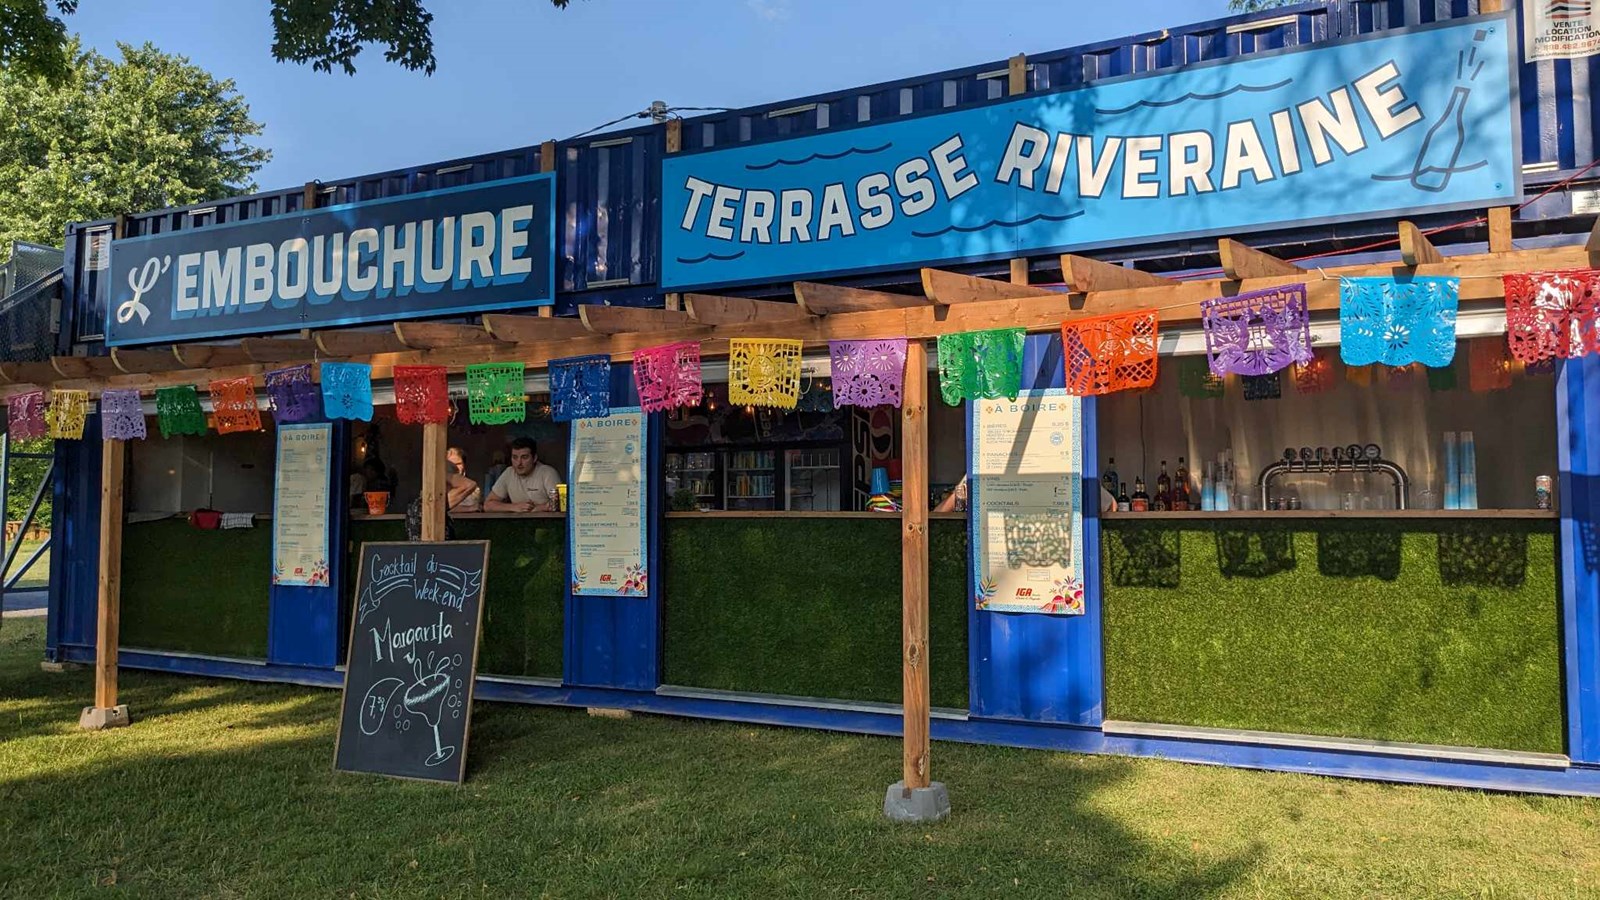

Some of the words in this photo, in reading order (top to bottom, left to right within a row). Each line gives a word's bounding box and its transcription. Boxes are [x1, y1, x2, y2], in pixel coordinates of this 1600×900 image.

[1553, 20, 1584, 28] VENTE
[1546, 25, 1592, 36] LOCATION
[1534, 30, 1600, 44] MODIFICATION
[680, 133, 979, 244] TERRASSE
[995, 59, 1425, 200] RIVERAINE
[1009, 403, 1058, 413] BOIRE
[597, 418, 631, 428] BOIRE
[371, 553, 417, 583] Cocktail
[426, 554, 438, 573] du
[600, 574, 612, 582] IGA
[413, 578, 466, 612] Week-end
[1015, 587, 1033, 597] IGA
[369, 611, 453, 664] Margarita
